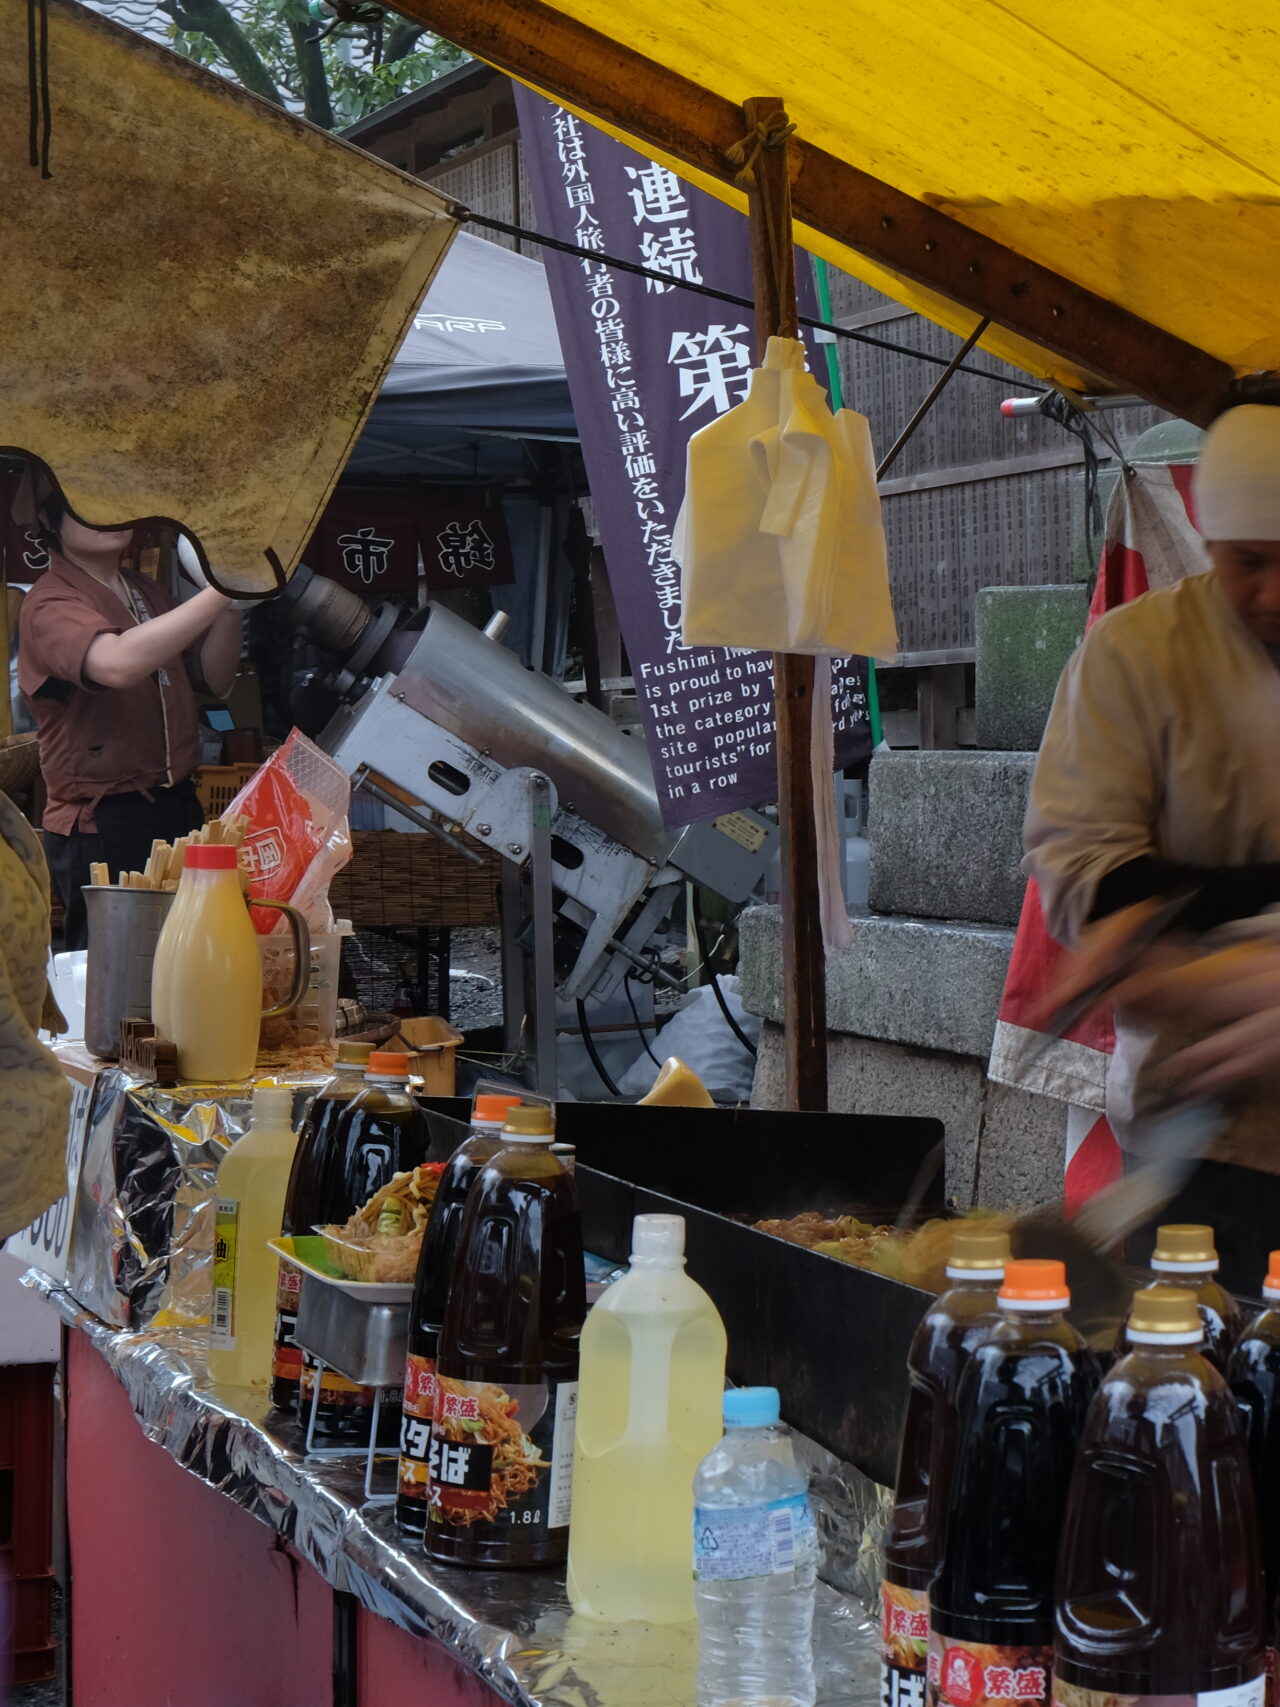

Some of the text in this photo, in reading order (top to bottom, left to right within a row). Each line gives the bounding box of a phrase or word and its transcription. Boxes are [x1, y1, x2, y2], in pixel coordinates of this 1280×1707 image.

[624, 161, 704, 294] 連続
[413, 318, 507, 333] ARP
[548, 101, 692, 654] 社は外国人旅行者の皆様に高い評価をいただきました
[640, 650, 716, 678] Fushimi
[645, 658, 773, 698] is proud to hav
[650, 701, 679, 718] 1st
[689, 690, 733, 712] prize
[741, 684, 760, 697] by
[656, 702, 771, 739] the category
[661, 741, 698, 758] site
[749, 741, 772, 757] for
[668, 772, 738, 798] in a row
[444, 1393, 480, 1421] 繁盛
[984, 1665, 1046, 1700] 繁盛
